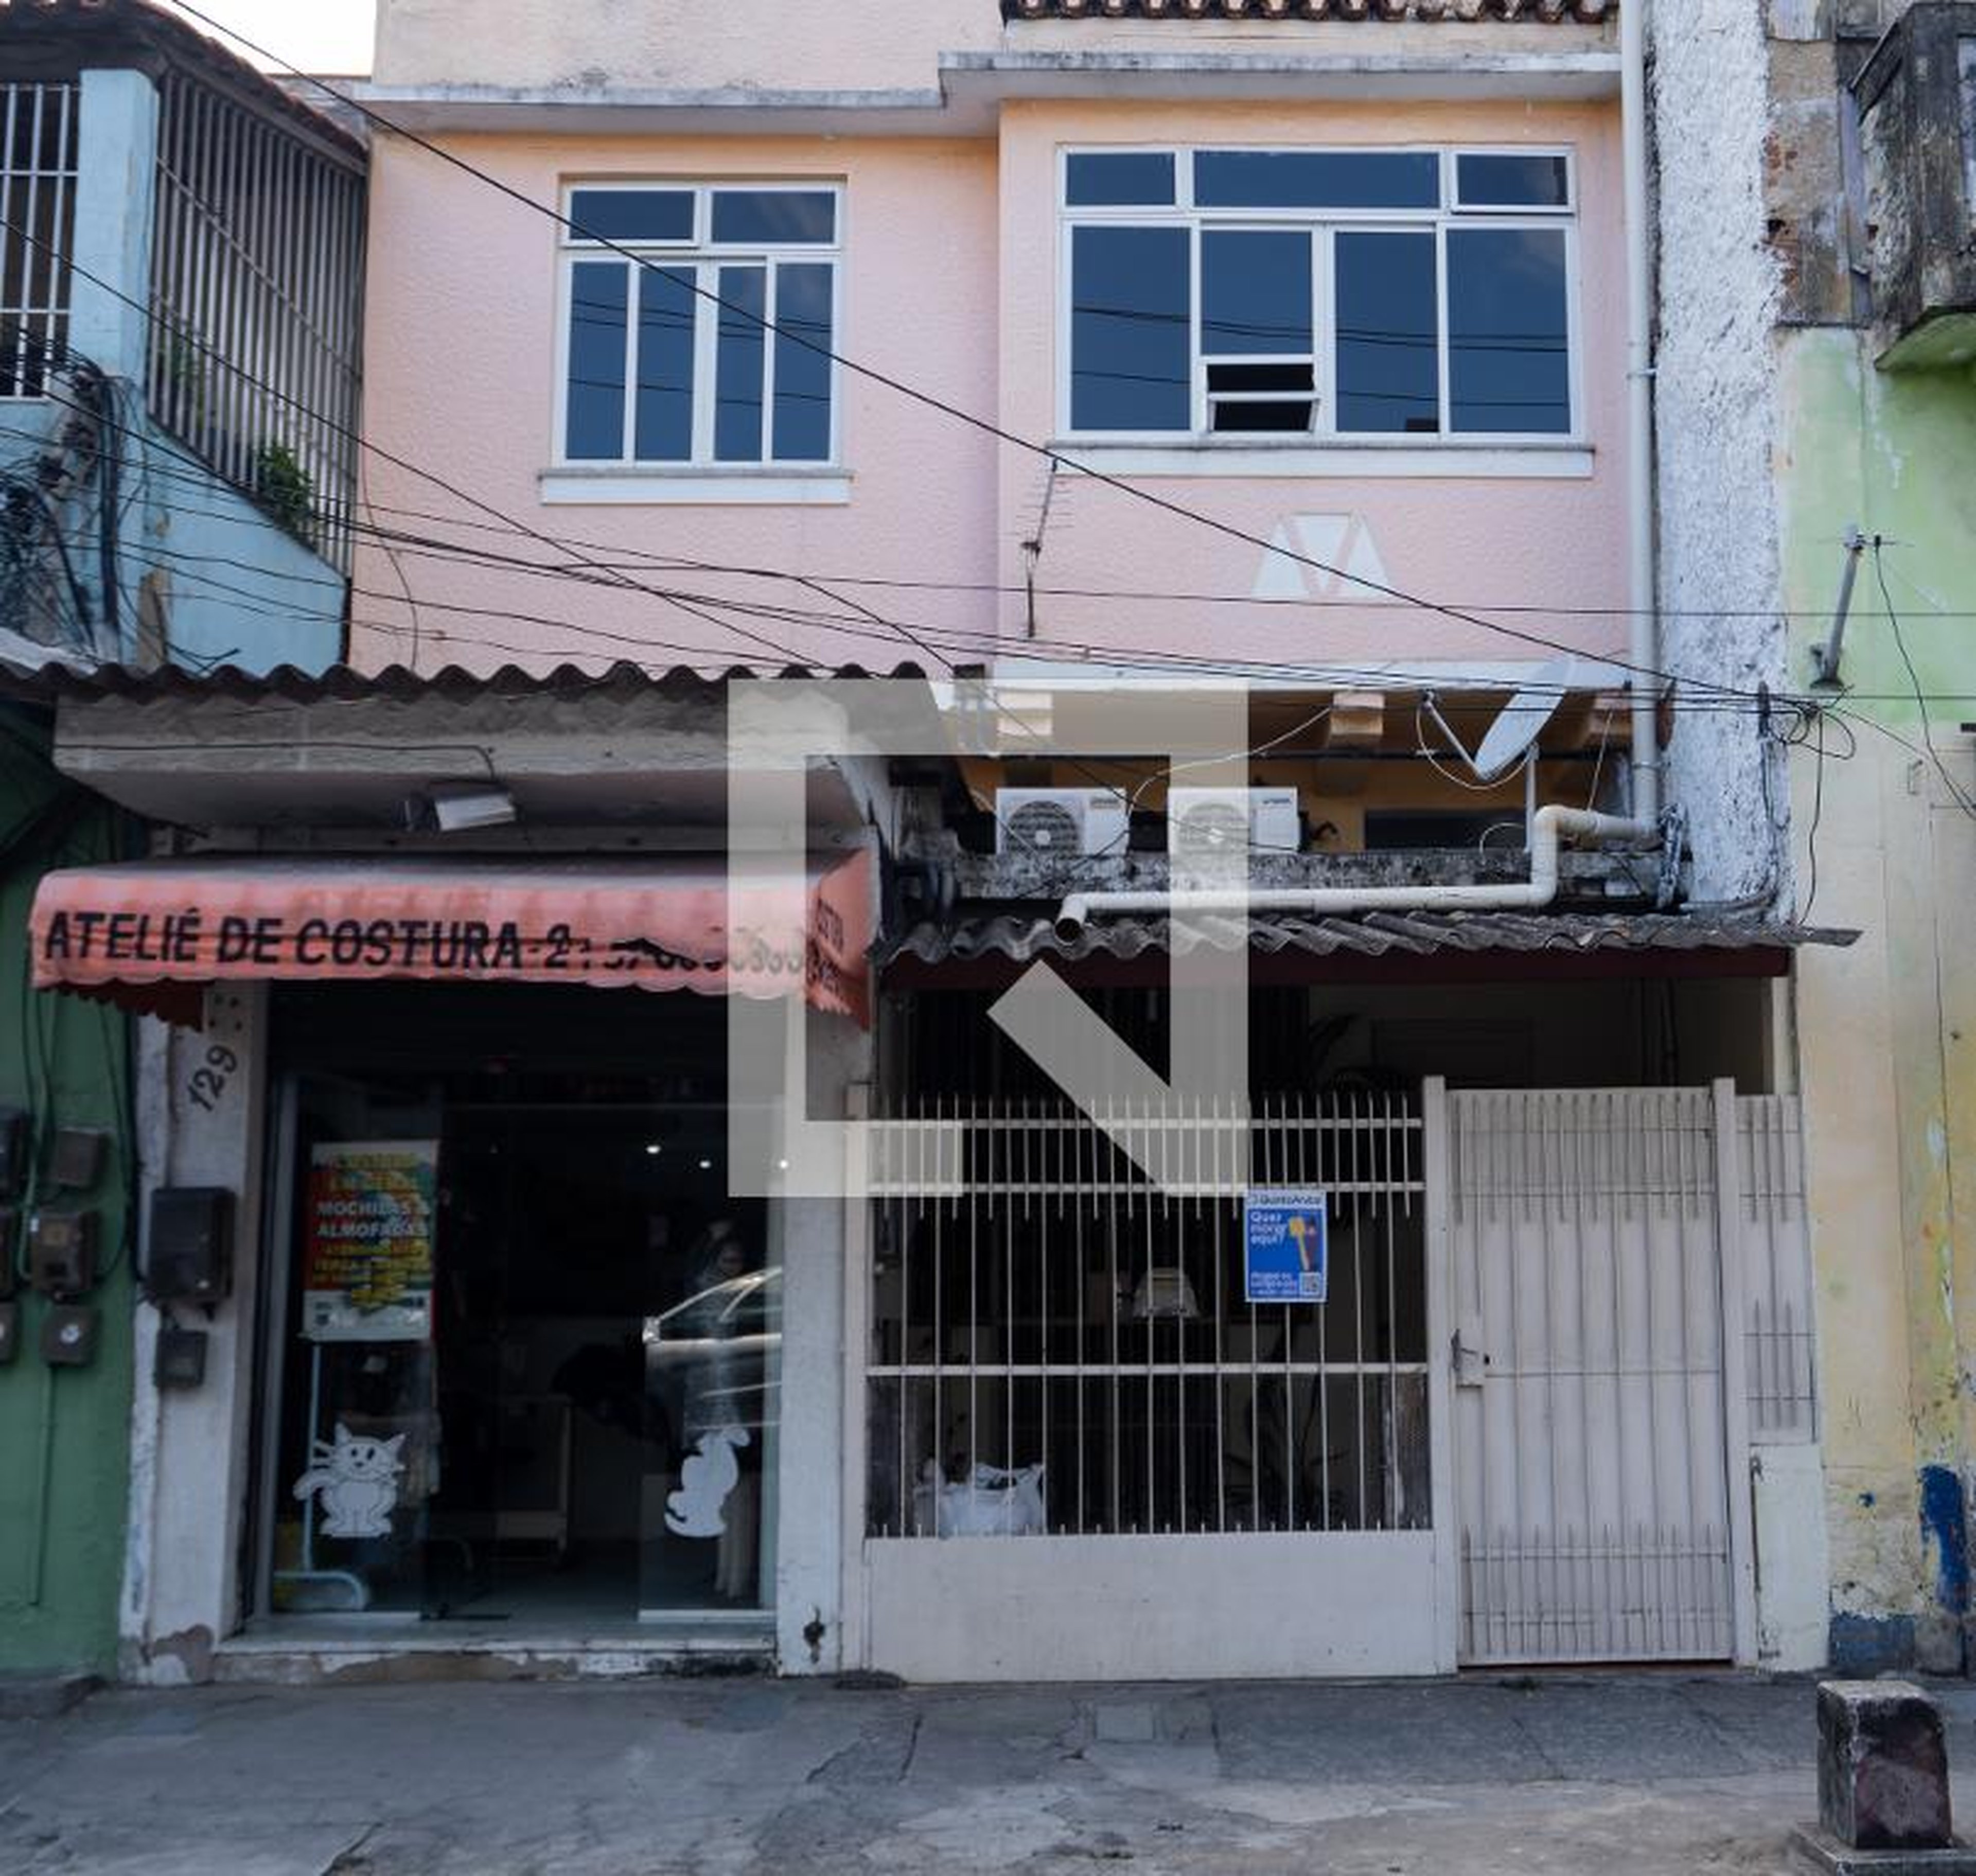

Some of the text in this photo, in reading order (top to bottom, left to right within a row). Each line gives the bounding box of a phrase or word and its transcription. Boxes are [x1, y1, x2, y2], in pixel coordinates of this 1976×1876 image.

[217, 916, 283, 963] DE
[295, 918, 522, 969] COSTURA
[187, 1045, 238, 1112] 129
